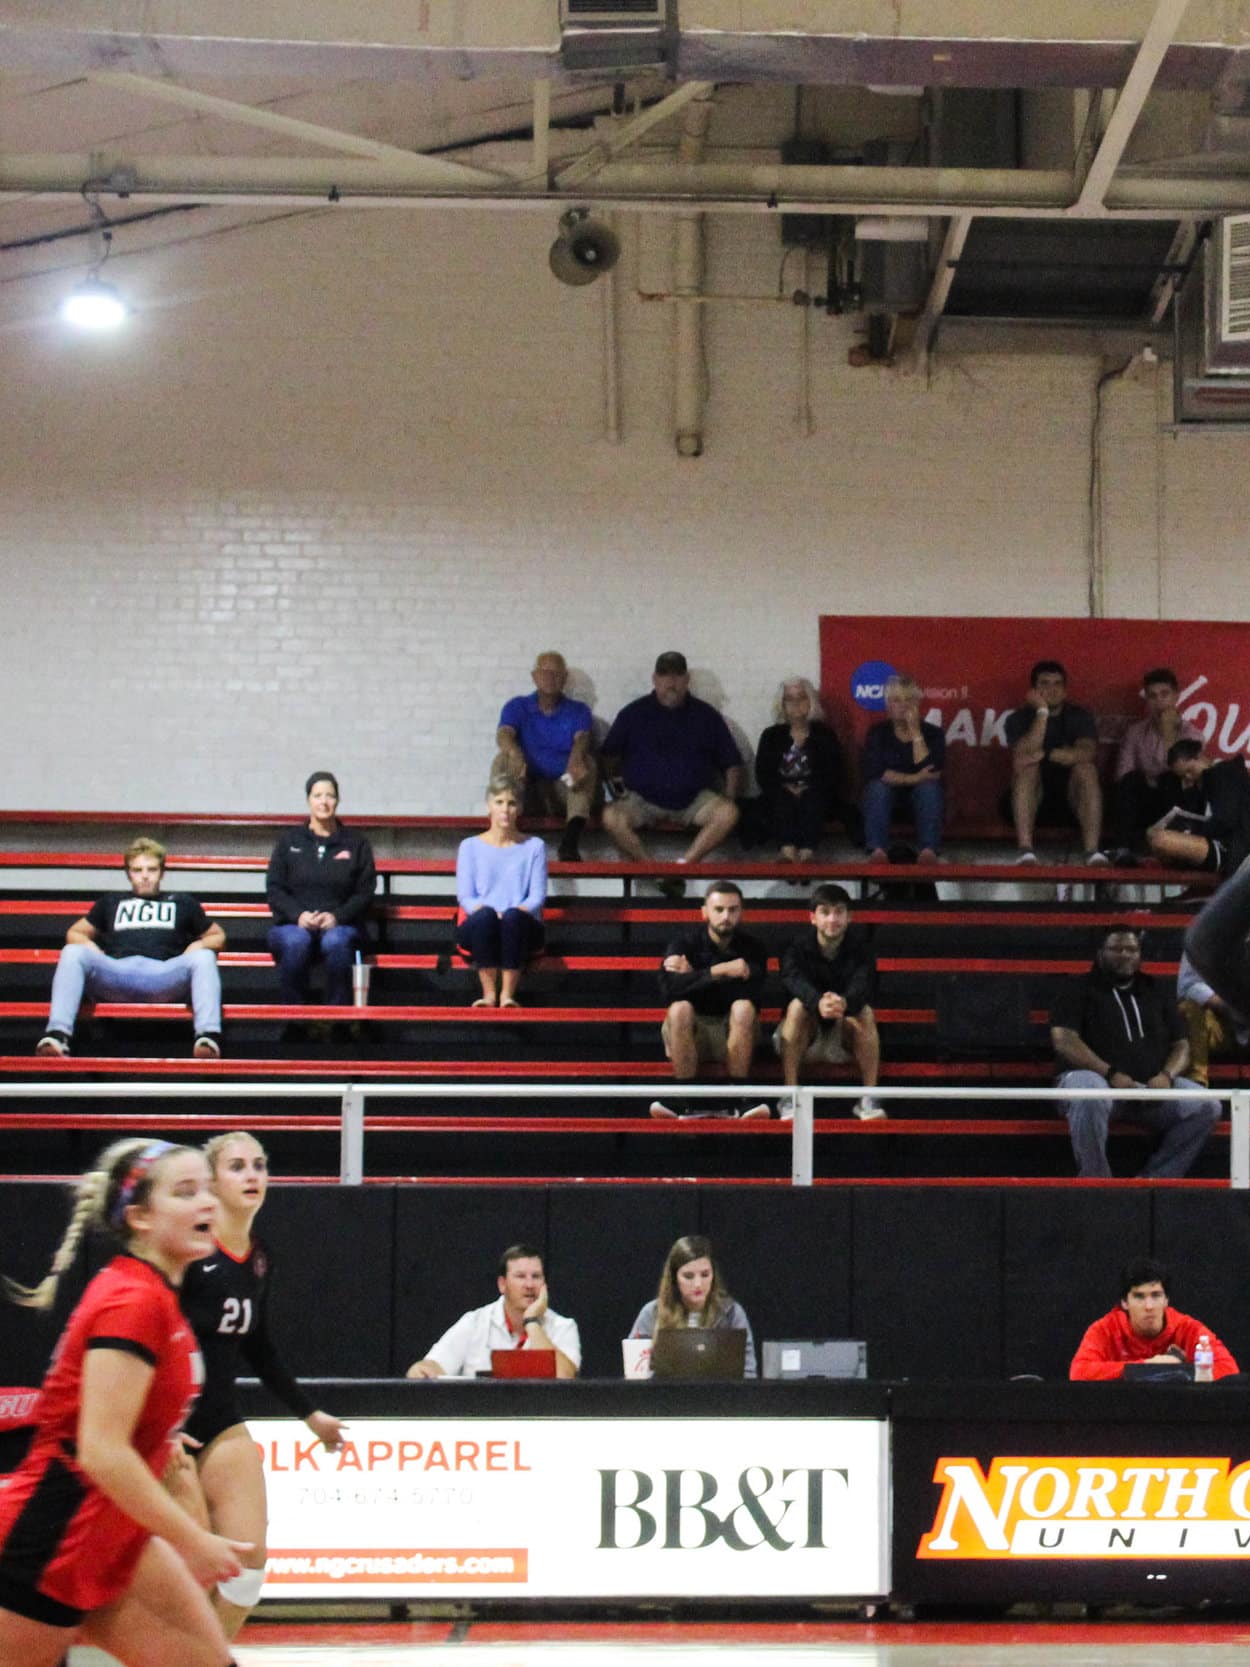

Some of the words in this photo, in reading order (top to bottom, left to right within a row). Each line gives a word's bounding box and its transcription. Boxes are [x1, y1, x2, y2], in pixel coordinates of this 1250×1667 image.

[856, 684, 884, 698] NC
[118, 900, 172, 923] NGU
[217, 1297, 252, 1334] 21
[336, 1441, 532, 1471] APPAREL
[593, 1466, 849, 1551] BB&T
[928, 1465, 1219, 1551] NORTH
